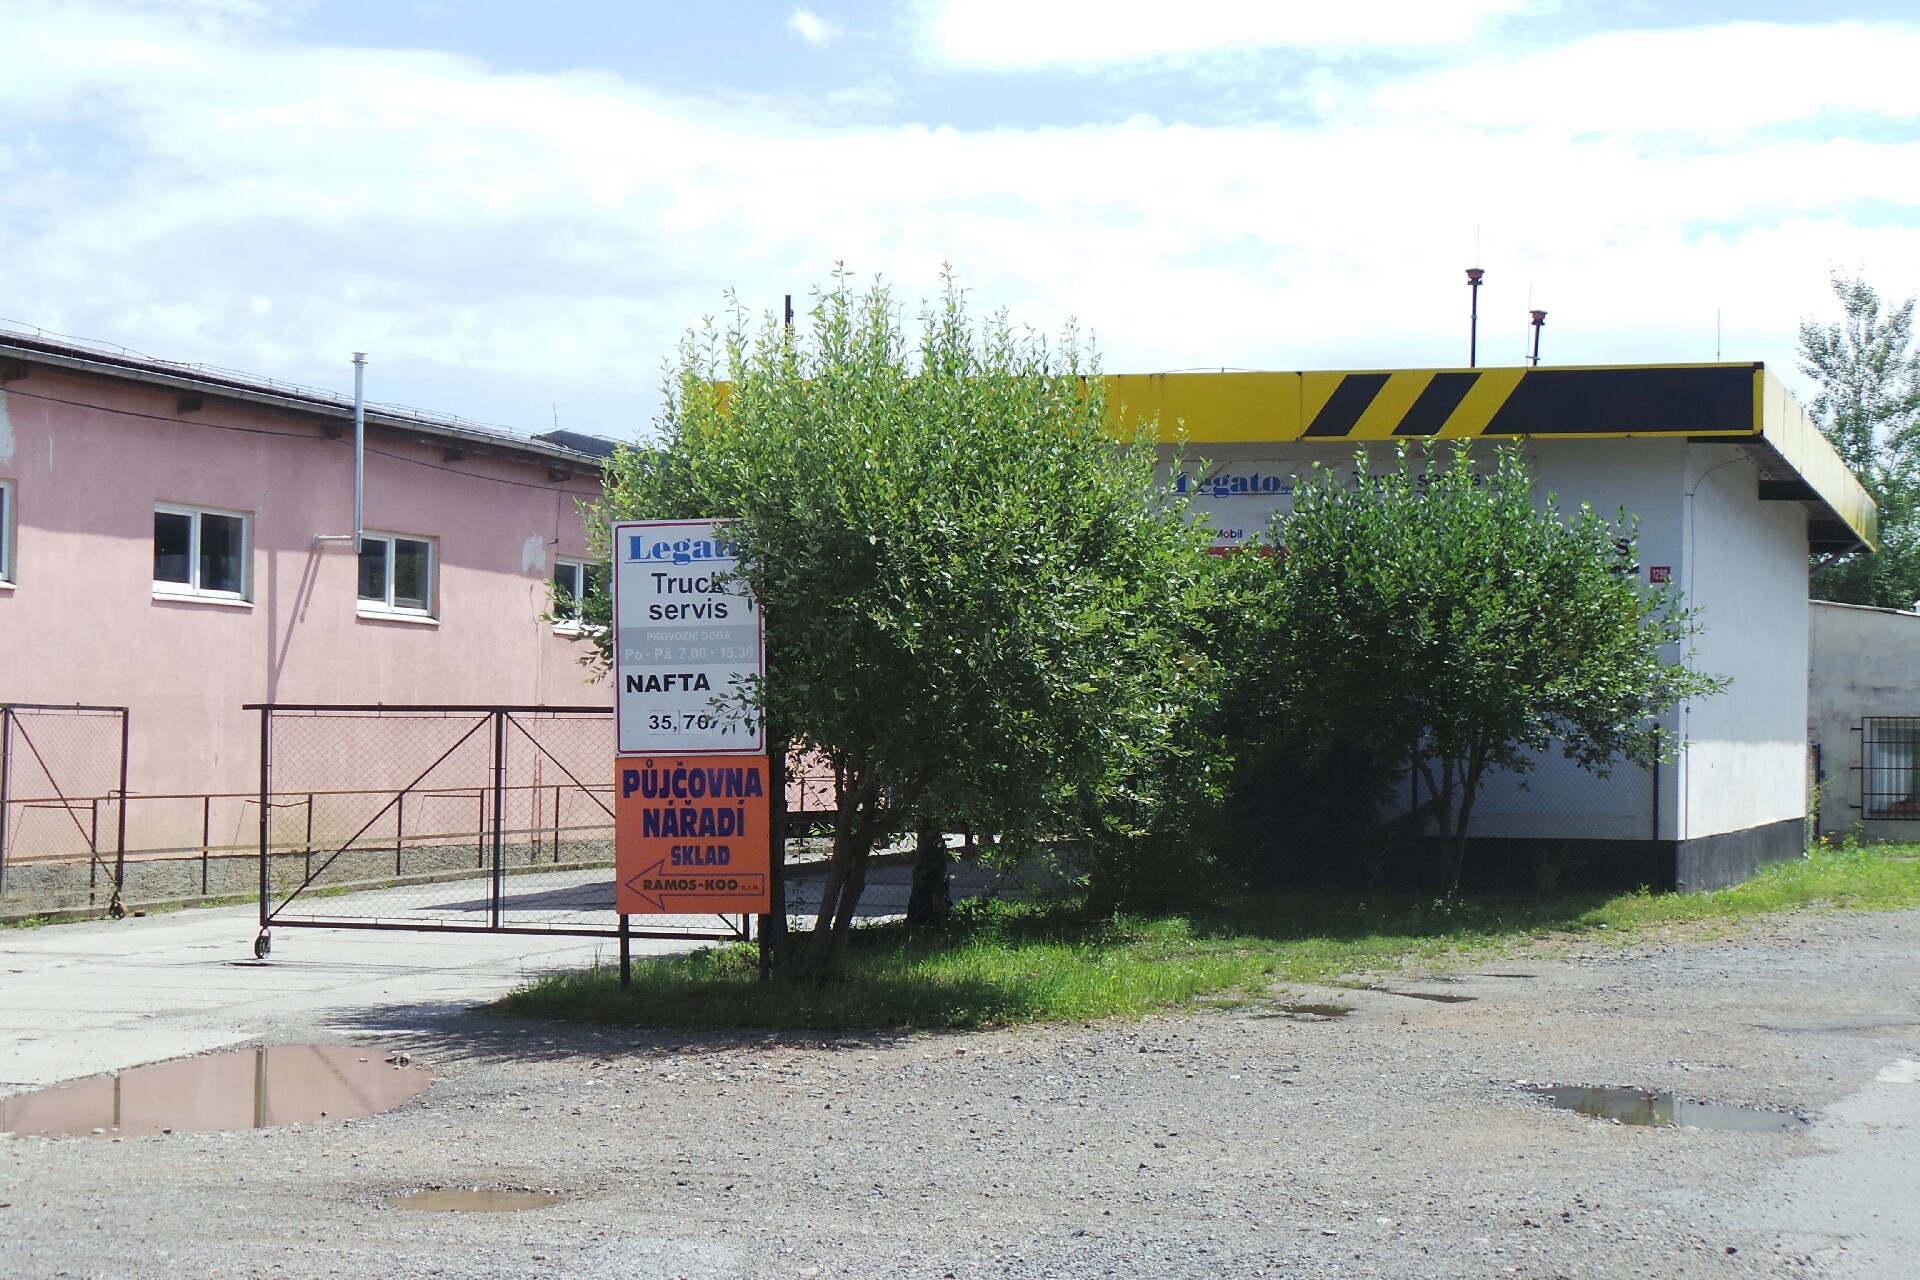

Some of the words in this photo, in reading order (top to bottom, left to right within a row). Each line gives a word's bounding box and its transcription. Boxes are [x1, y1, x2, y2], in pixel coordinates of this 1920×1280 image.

[649, 598, 728, 620] servis
[646, 630, 699, 641] PROVOZNÍ
[701, 630, 731, 640] DOBA
[678, 648, 706, 659] 7.00
[719, 646, 754, 658] 15.30
[626, 673, 711, 693] NAFTA
[622, 759, 763, 798] PŮJČOVNA
[642, 800, 745, 838] NÁŘADÍ
[671, 845, 731, 866] SKLAD
